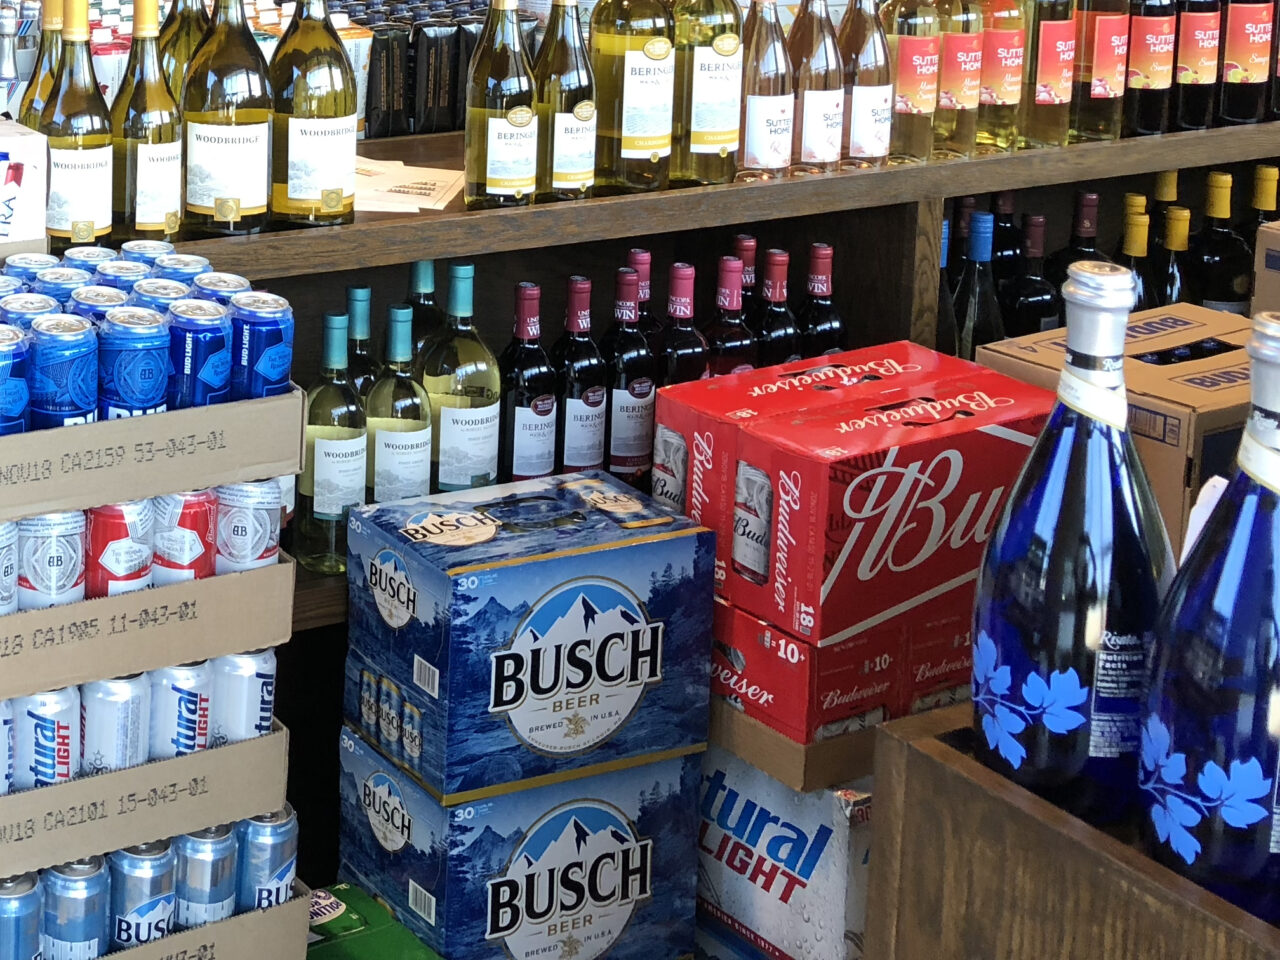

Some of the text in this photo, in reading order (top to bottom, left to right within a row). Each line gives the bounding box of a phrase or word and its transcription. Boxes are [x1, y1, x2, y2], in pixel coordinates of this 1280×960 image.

[1146, 34, 1175, 44] SUTTE
[1245, 22, 1273, 33] SUTTE
[912, 54, 938, 65] SUTTE
[195, 133, 260, 145] WOODBRIDGE
[184, 331, 193, 375] BUD LIGHT
[241, 323, 250, 366] BUD LIGHT
[747, 357, 923, 398] Budweiser
[835, 390, 1015, 434] Budweiser
[60, 444, 126, 476] CA2159
[133, 430, 228, 465] 53-043-01
[652, 473, 685, 505] Bud
[690, 430, 715, 528] Budwe
[349, 516, 363, 535] 30
[399, 511, 501, 542] BUSCH
[732, 516, 768, 547] Bud
[776, 469, 802, 614] Budweiser
[457, 575, 479, 591] 30
[714, 558, 727, 581] 18
[368, 561, 418, 617] BUSCH
[800, 604, 815, 628] 18
[488, 620, 665, 714] BUSCH
[915, 654, 972, 681] Budweise
[1098, 661, 1127, 669] Facts
[1099, 653, 1143, 661] Nutrition
[711, 662, 776, 709] weiser
[820, 682, 891, 710] Budweiser
[254, 671, 275, 735] tural
[551, 691, 601, 713] BEER
[528, 720, 565, 734] BREWED
[590, 713, 599, 722] IN
[27, 709, 57, 788] atural
[56, 720, 71, 779] LIGHT
[341, 735, 355, 753] 30
[43, 801, 109, 834] CA2101
[116, 776, 210, 815] 15-043-01
[361, 781, 413, 841] BUSCH
[453, 806, 475, 822] 30
[700, 768, 834, 882] tural
[697, 819, 808, 906] LIGHT
[485, 839, 654, 941] BUSCH
[546, 914, 593, 938] BEER
[524, 935, 593, 958] BREWED IN
